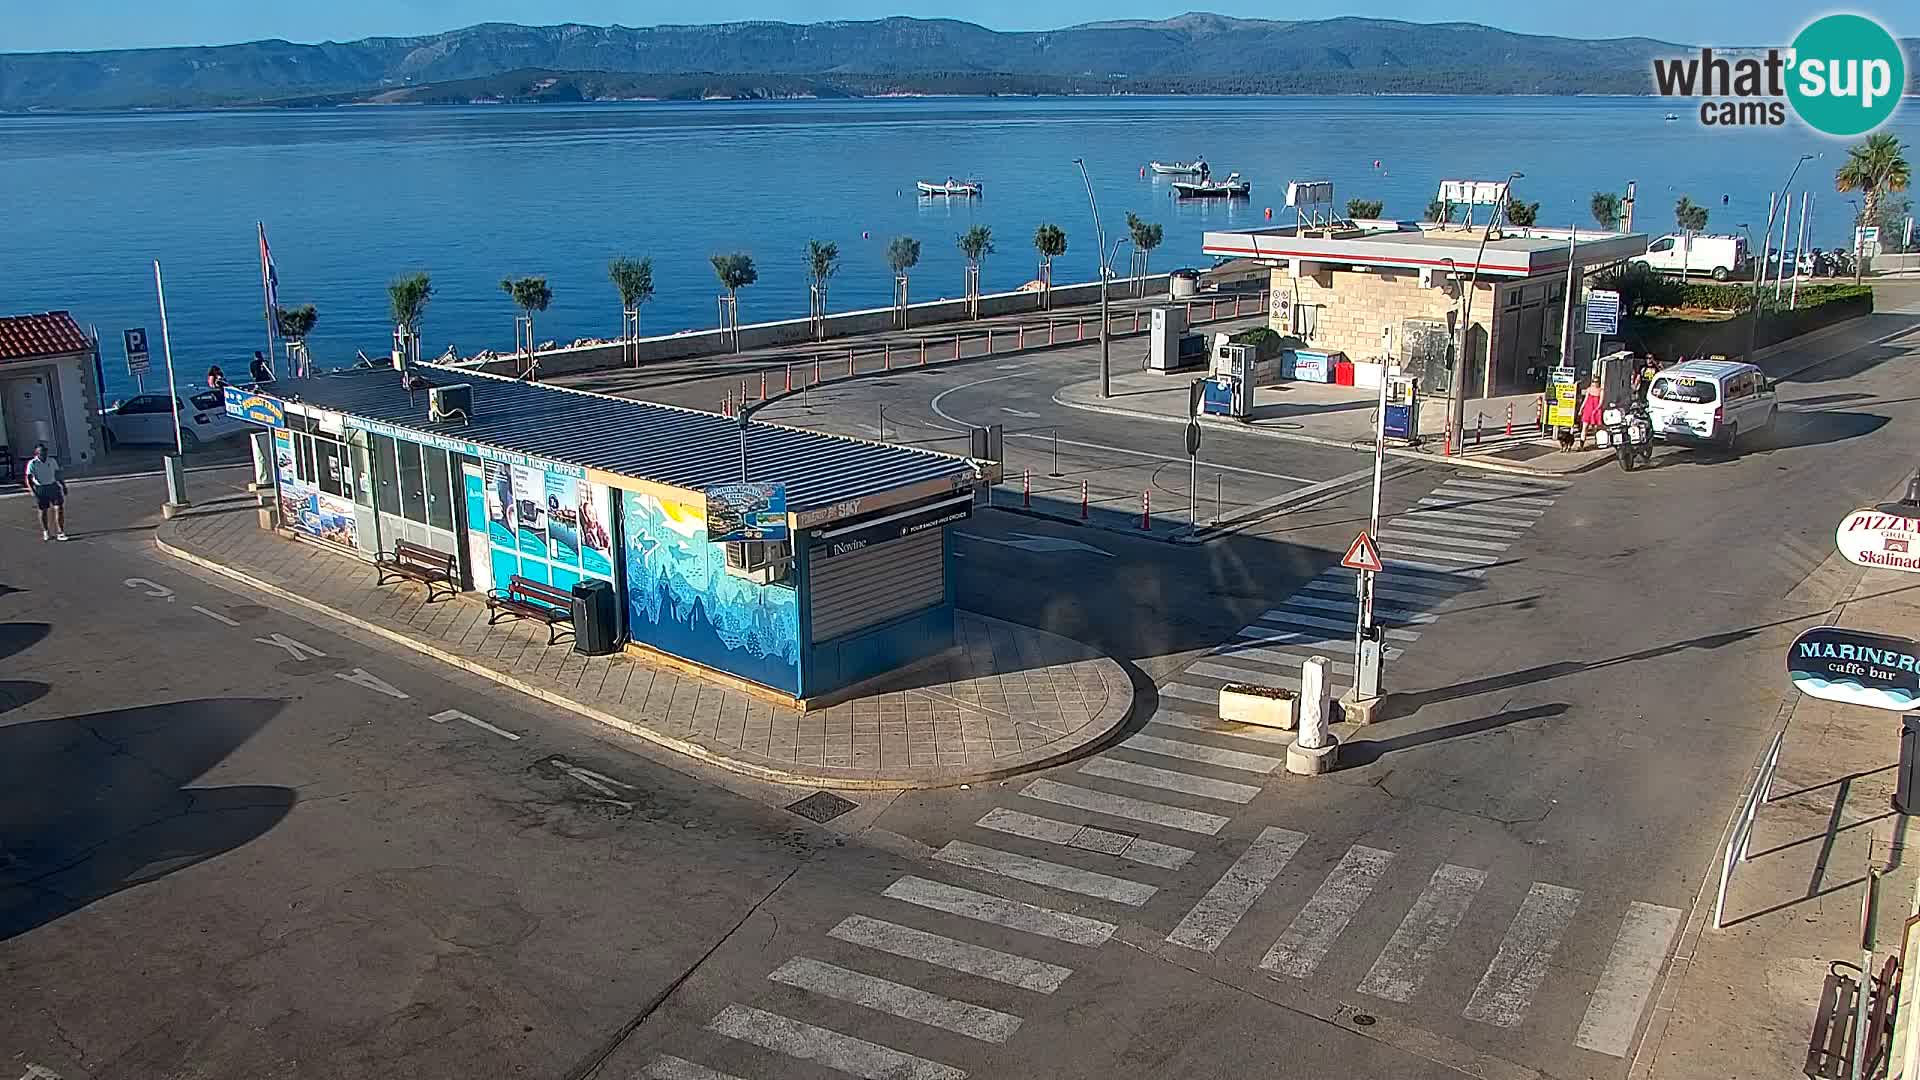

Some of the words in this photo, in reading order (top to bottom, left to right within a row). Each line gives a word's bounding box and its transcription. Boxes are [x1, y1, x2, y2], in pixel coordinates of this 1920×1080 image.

[493, 449, 526, 464] STATION
[527, 456, 554, 471] TICKET
[554, 462, 582, 477] OFFICE
[1848, 514, 1920, 534] PIZZE
[1829, 662, 1865, 675] caffe
[1869, 666, 1896, 681] bar
